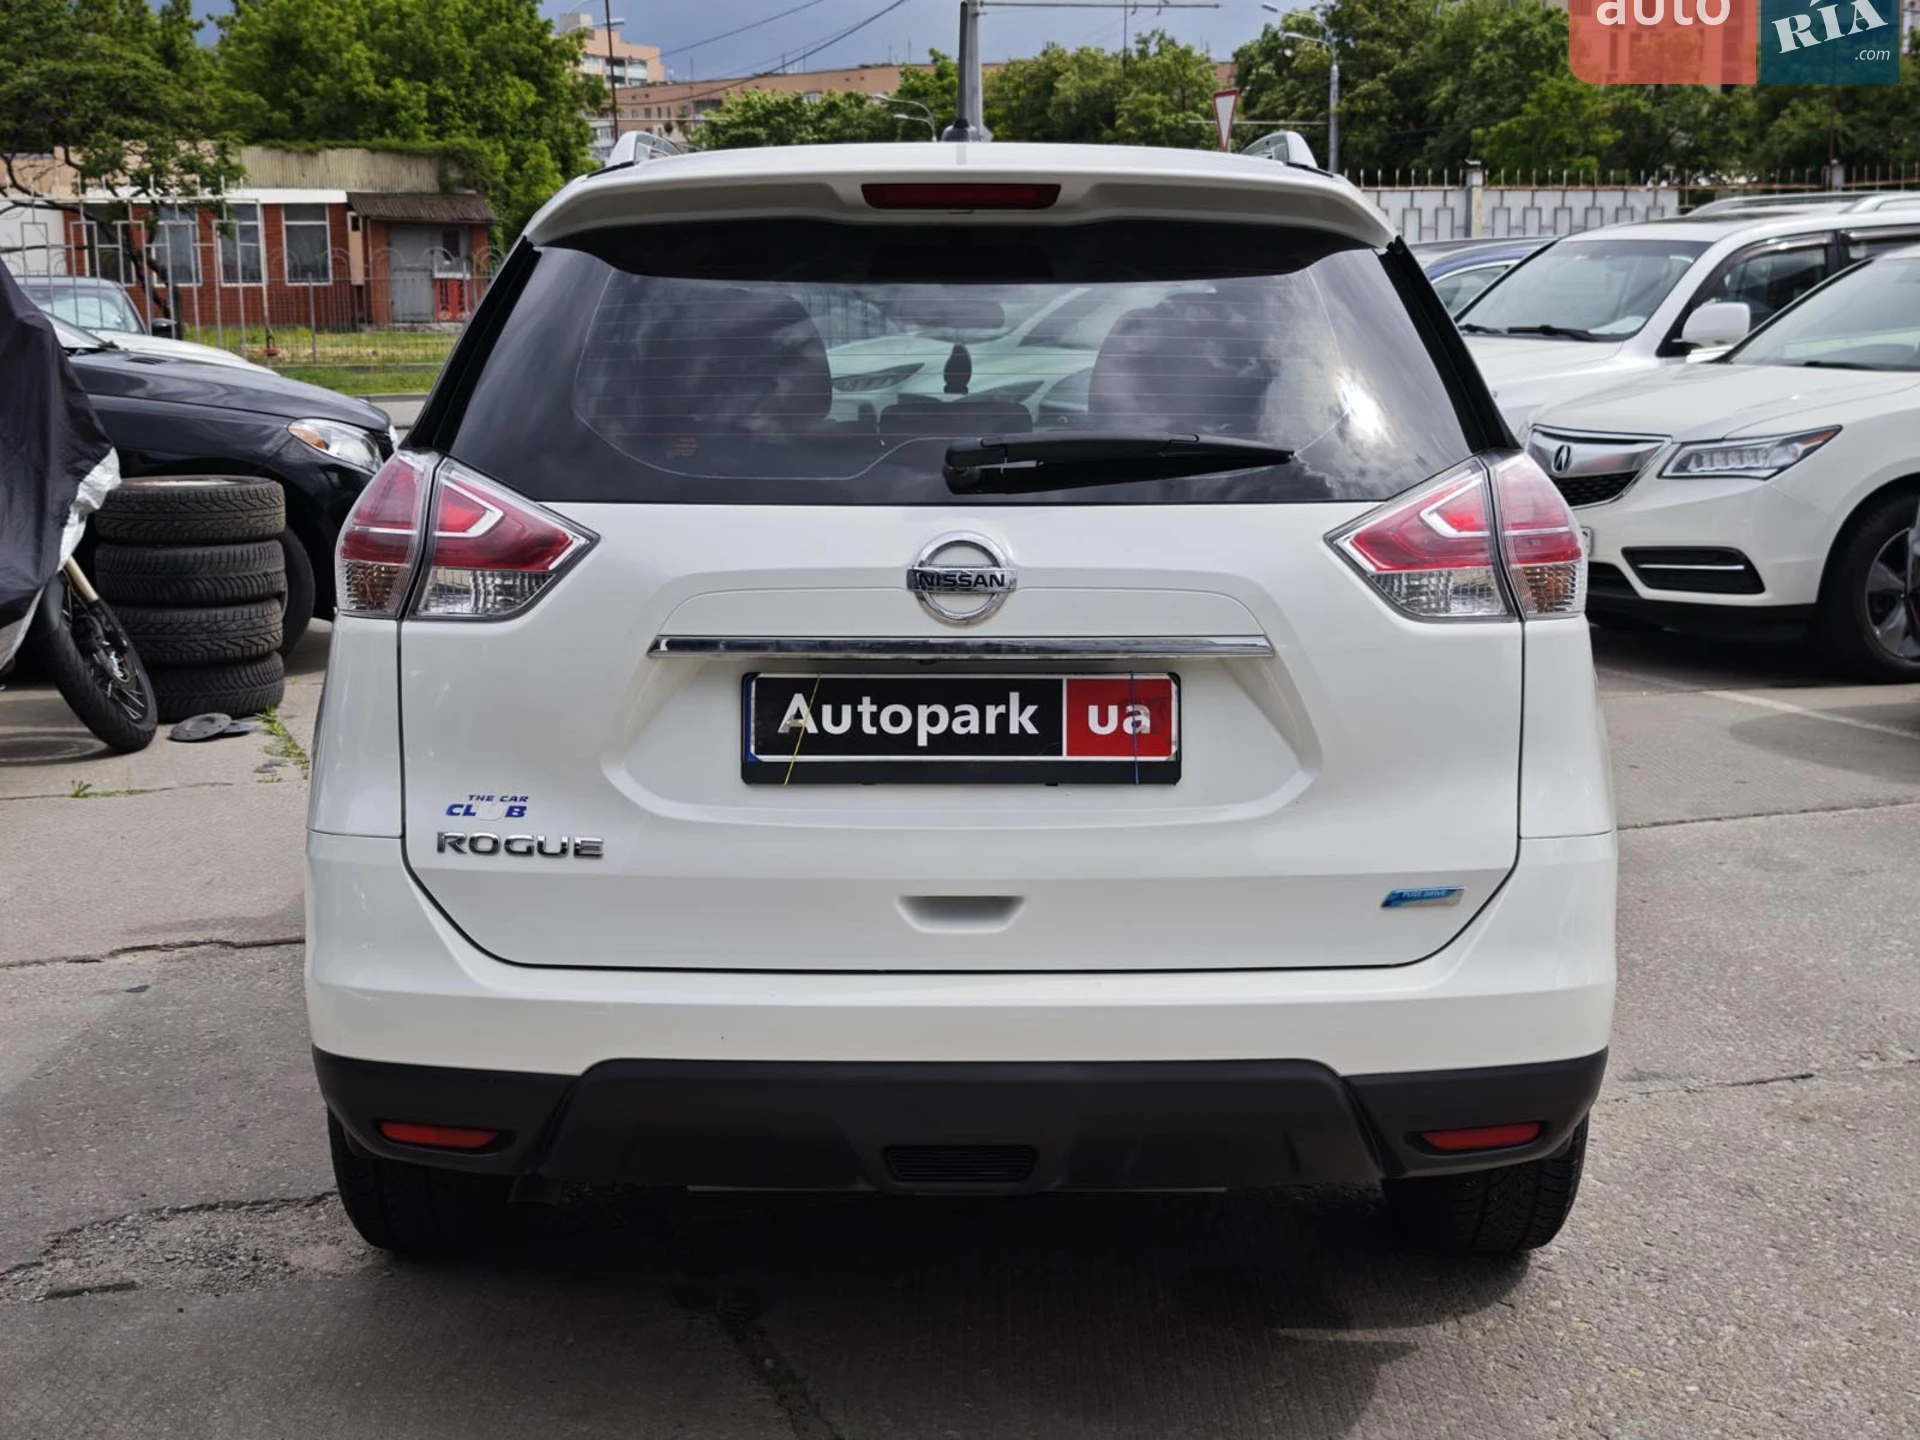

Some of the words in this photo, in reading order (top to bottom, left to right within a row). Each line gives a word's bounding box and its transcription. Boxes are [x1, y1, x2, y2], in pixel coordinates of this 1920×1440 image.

[918, 573, 1006, 588] NISSAN
[777, 691, 1039, 747] Autopark
[1086, 703, 1152, 735] ua
[468, 794, 496, 803] THE
[499, 795, 529, 803] CAR
[436, 831, 604, 859] ROGUE
